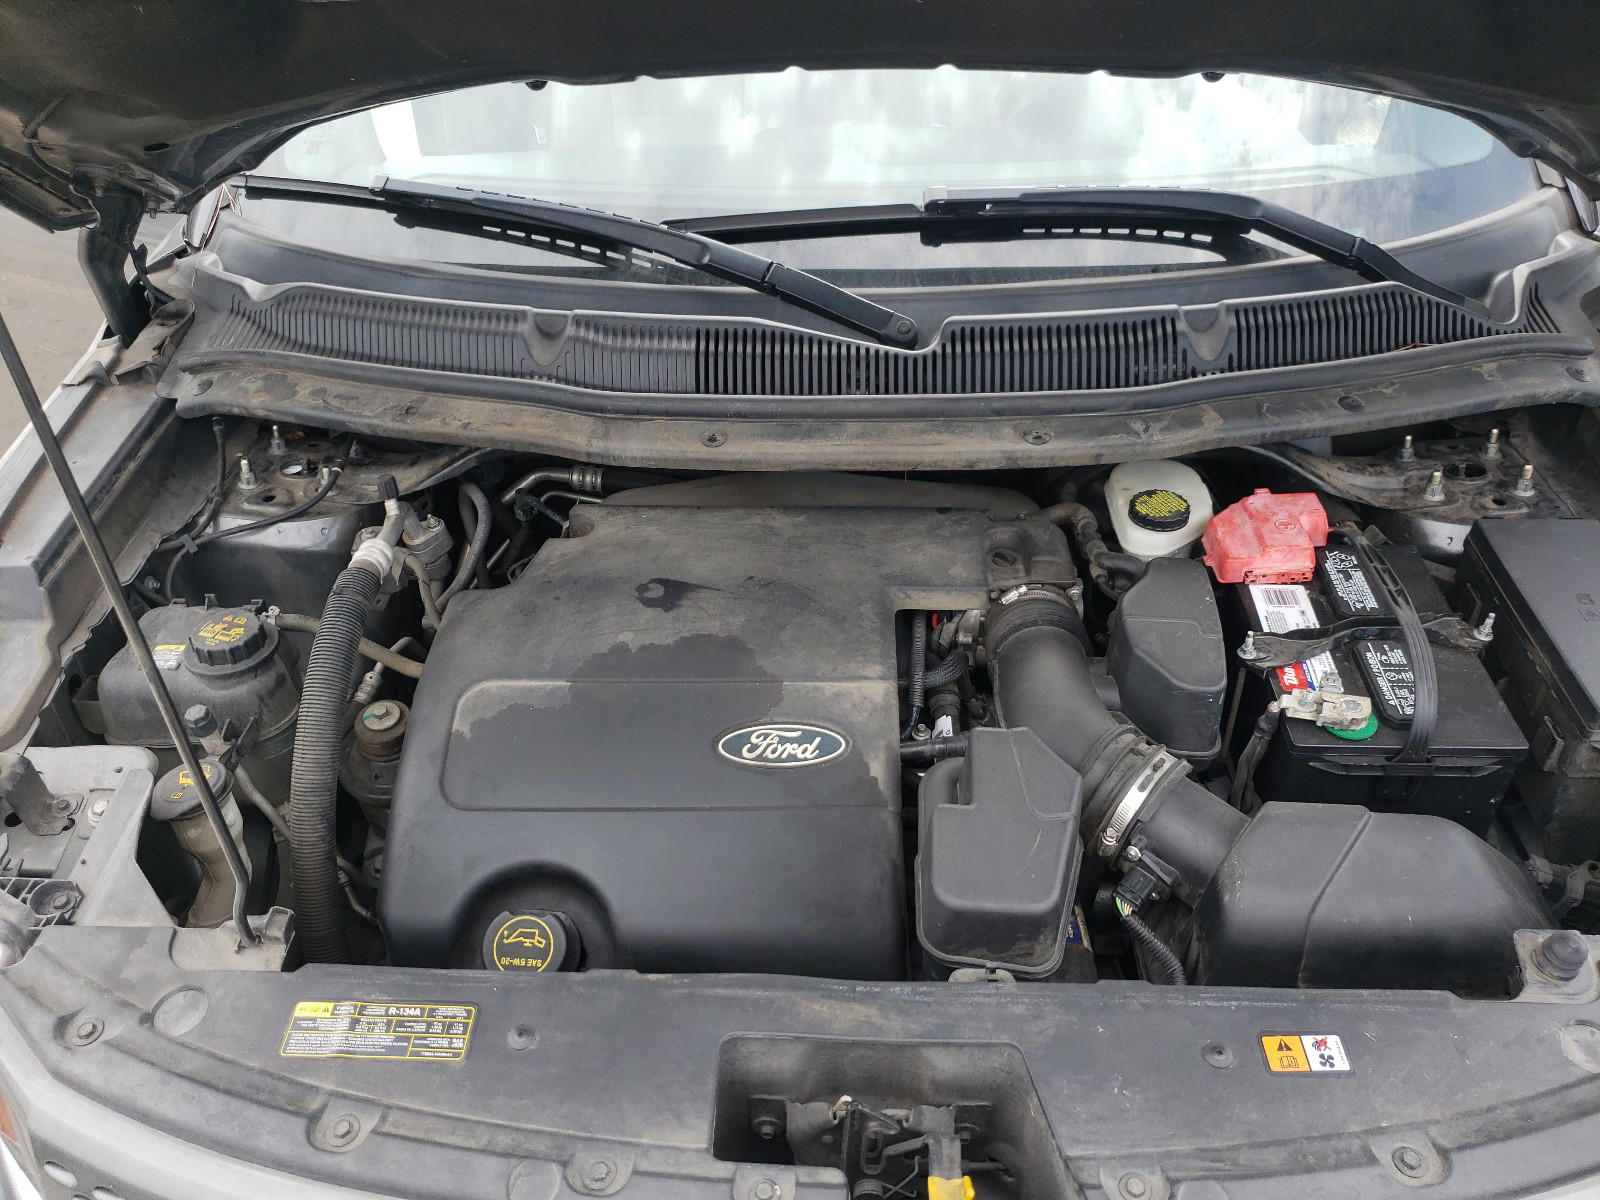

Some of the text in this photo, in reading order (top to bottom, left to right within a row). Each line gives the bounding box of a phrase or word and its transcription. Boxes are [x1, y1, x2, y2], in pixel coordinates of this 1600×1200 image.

[741, 729, 822, 760] Ford
[500, 956, 542, 968] SAE 5W-20
[388, 1006, 421, 1017] R-134A
